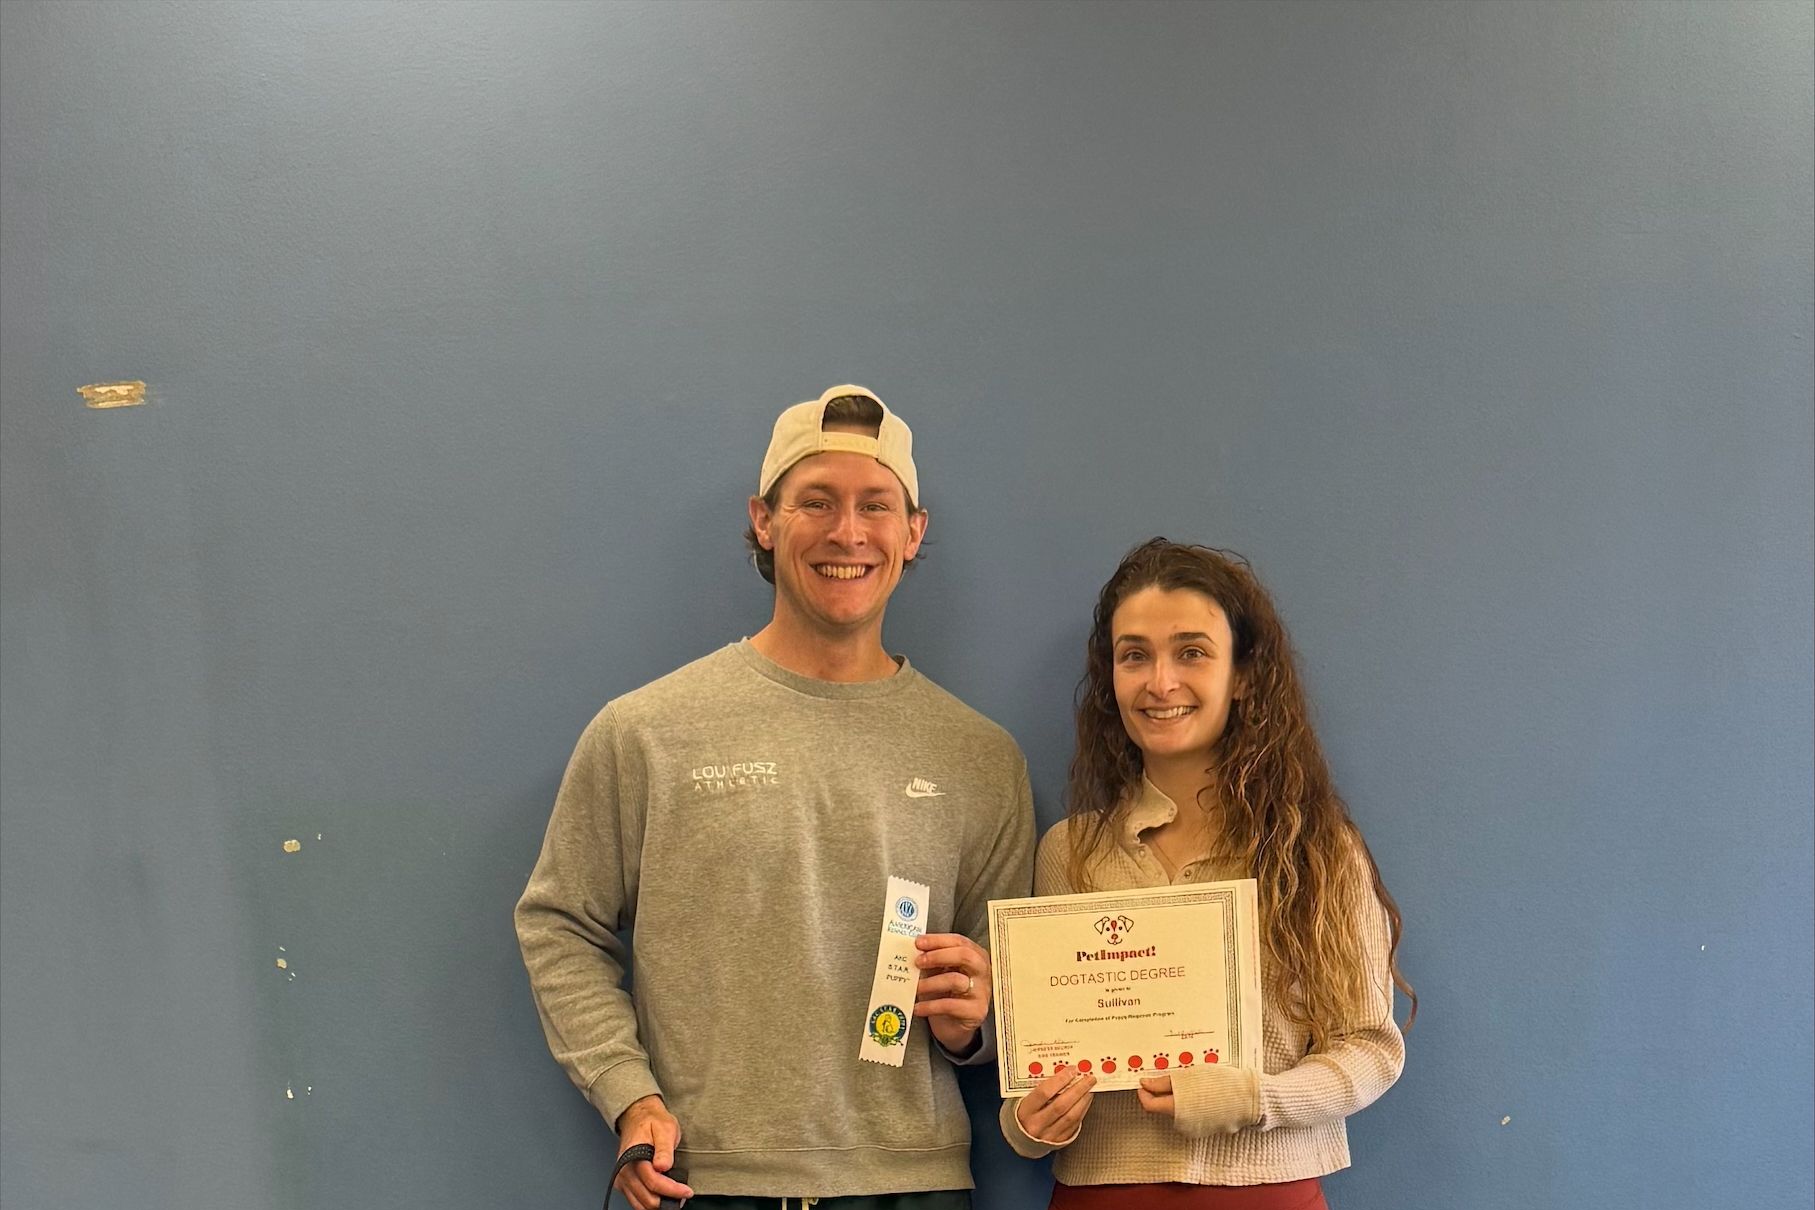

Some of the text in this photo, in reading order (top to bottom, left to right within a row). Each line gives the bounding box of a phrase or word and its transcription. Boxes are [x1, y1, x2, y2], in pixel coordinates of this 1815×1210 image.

[692, 762, 778, 780] LOU FUSZ
[694, 775, 779, 792] ATHLETIC
[912, 777, 938, 793] NIKE
[1075, 945, 1157, 962] PetImpact!
[1049, 966, 1186, 987] DOGTASTIC DEGREE
[1097, 997, 1141, 1009] Sullivan
